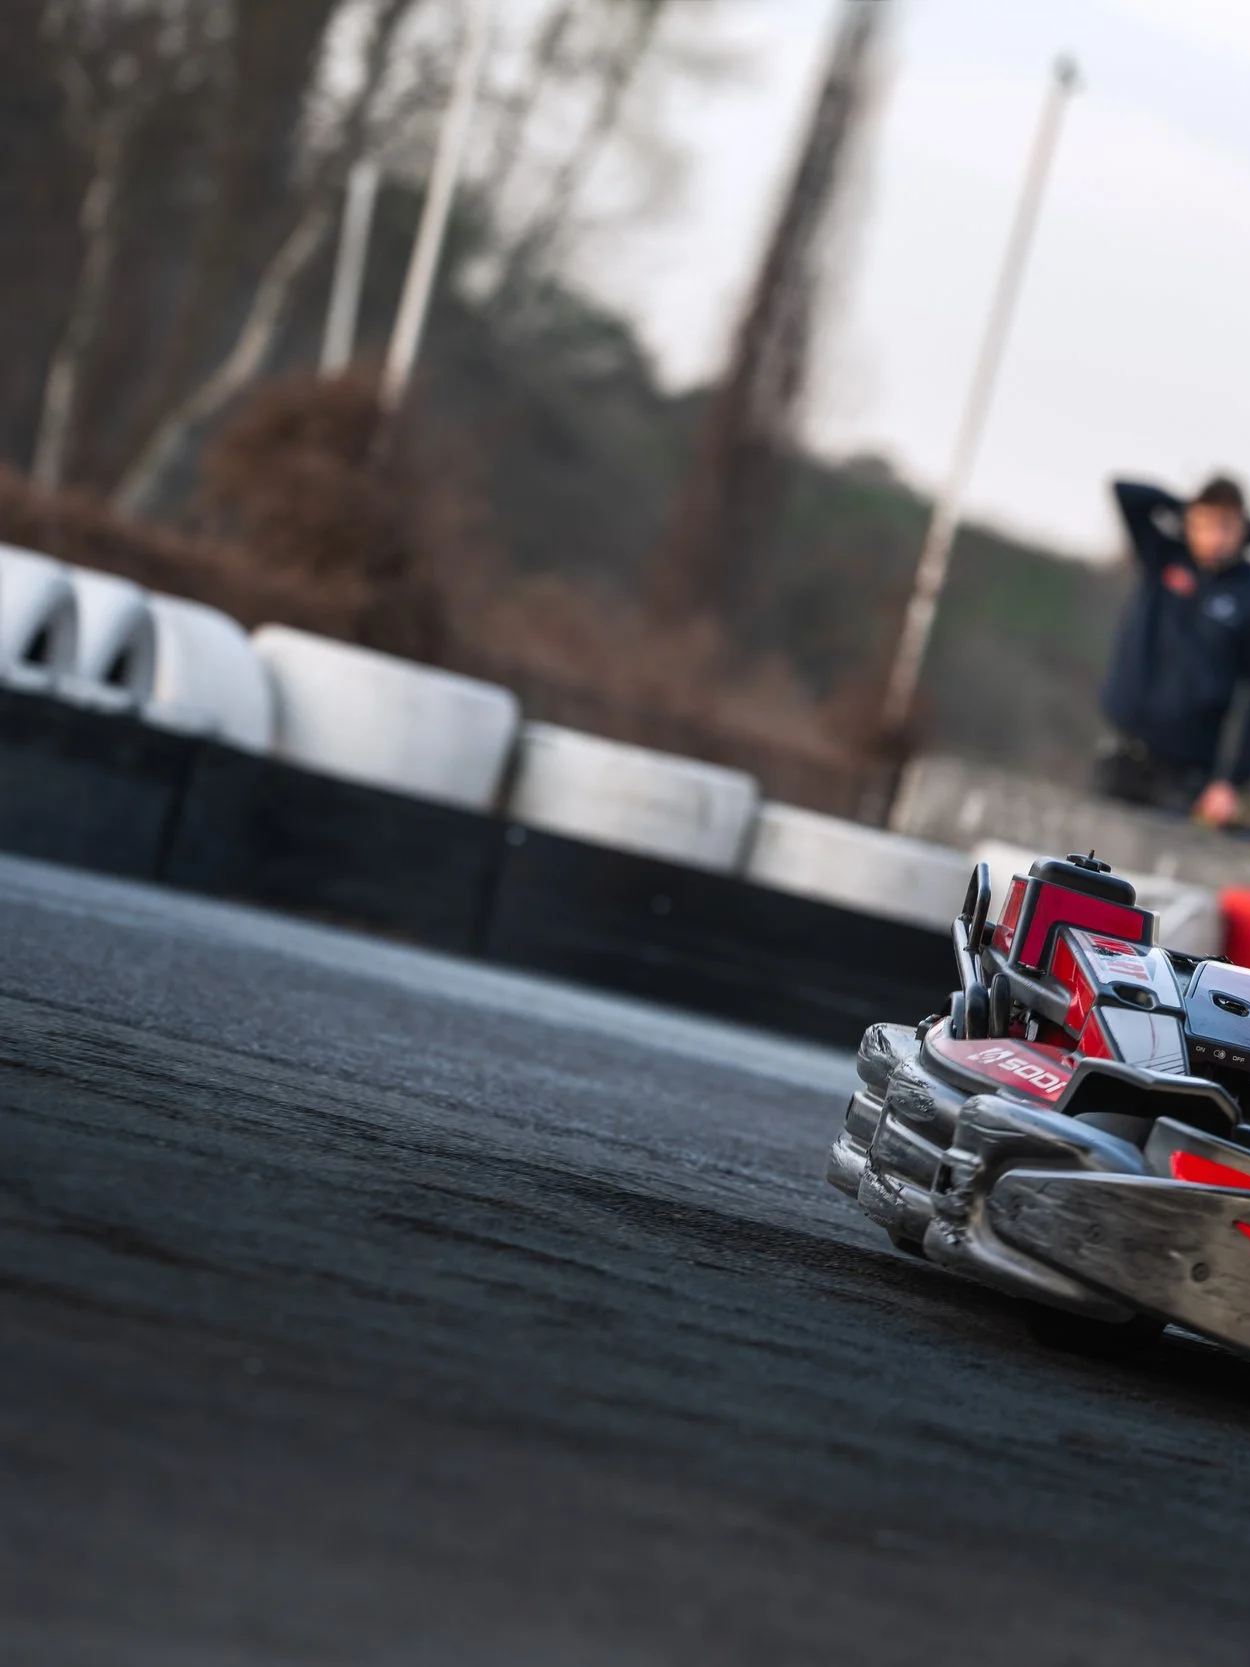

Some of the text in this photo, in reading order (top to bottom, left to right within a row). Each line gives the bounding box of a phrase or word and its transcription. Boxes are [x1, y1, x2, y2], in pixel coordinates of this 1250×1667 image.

[1195, 1045, 1206, 1053] ON
[1232, 1055, 1246, 1063] OFF
[996, 1057, 1068, 1094] SODI
